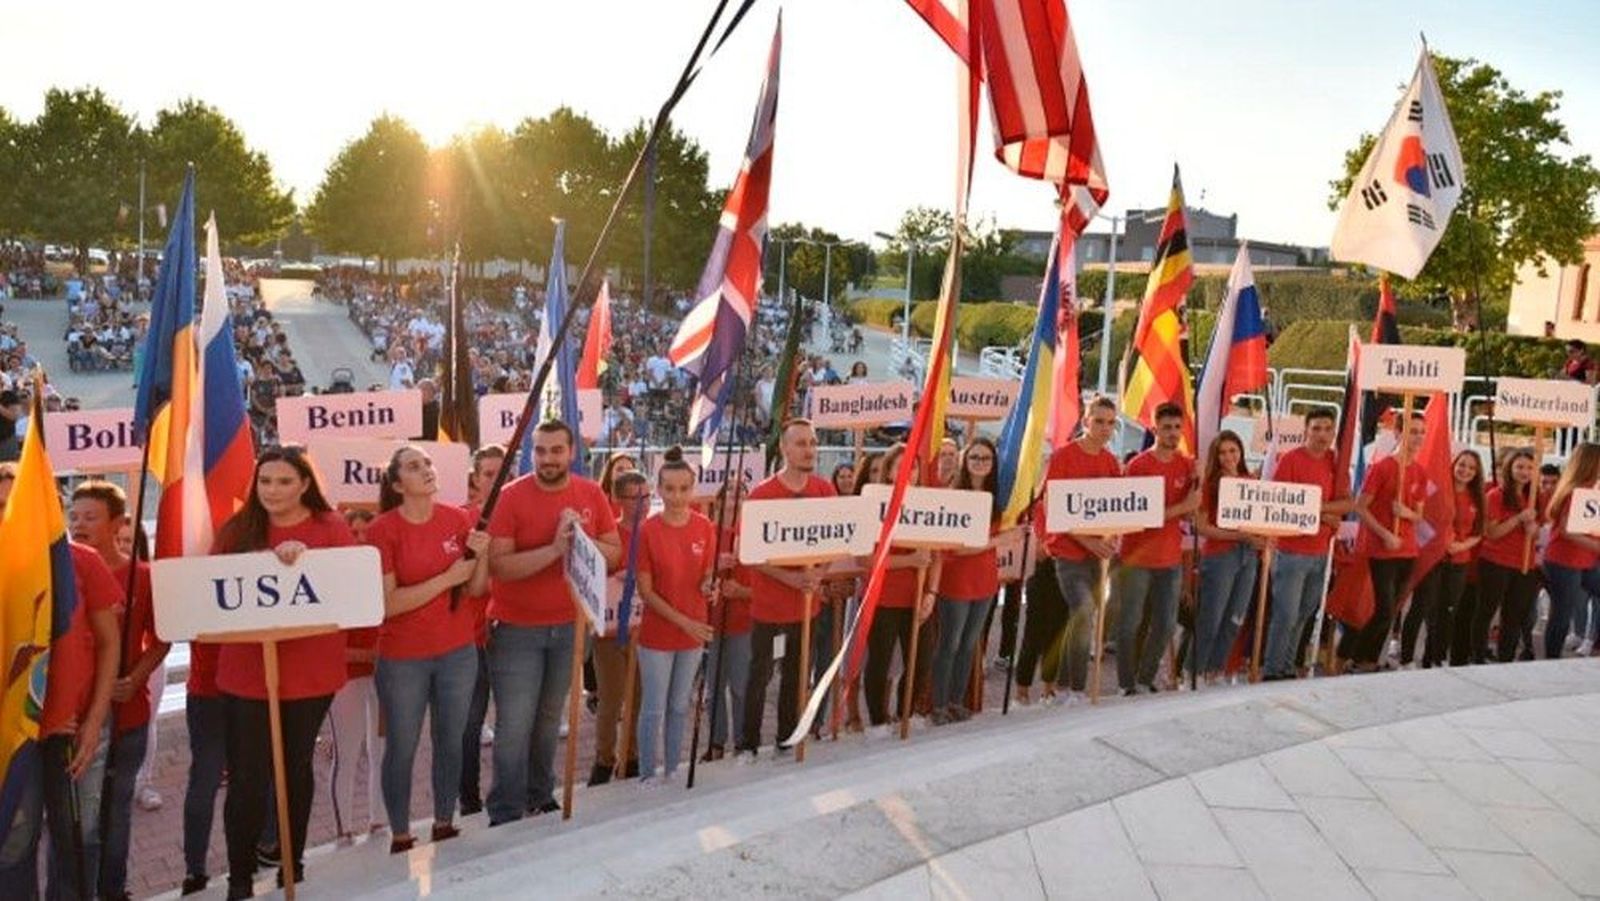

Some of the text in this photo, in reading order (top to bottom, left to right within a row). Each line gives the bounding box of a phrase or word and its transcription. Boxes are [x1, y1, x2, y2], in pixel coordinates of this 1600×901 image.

[1383, 358, 1438, 377] Tahiti
[819, 393, 908, 414] Bangladesh
[1501, 391, 1589, 413] Switzerland
[308, 402, 394, 430] Benin
[1066, 491, 1148, 520] Uganda
[1236, 483, 1305, 506] Trinidad
[1221, 504, 1317, 528] and Tobago
[762, 520, 856, 546] Uruguay
[212, 573, 321, 611] USA
